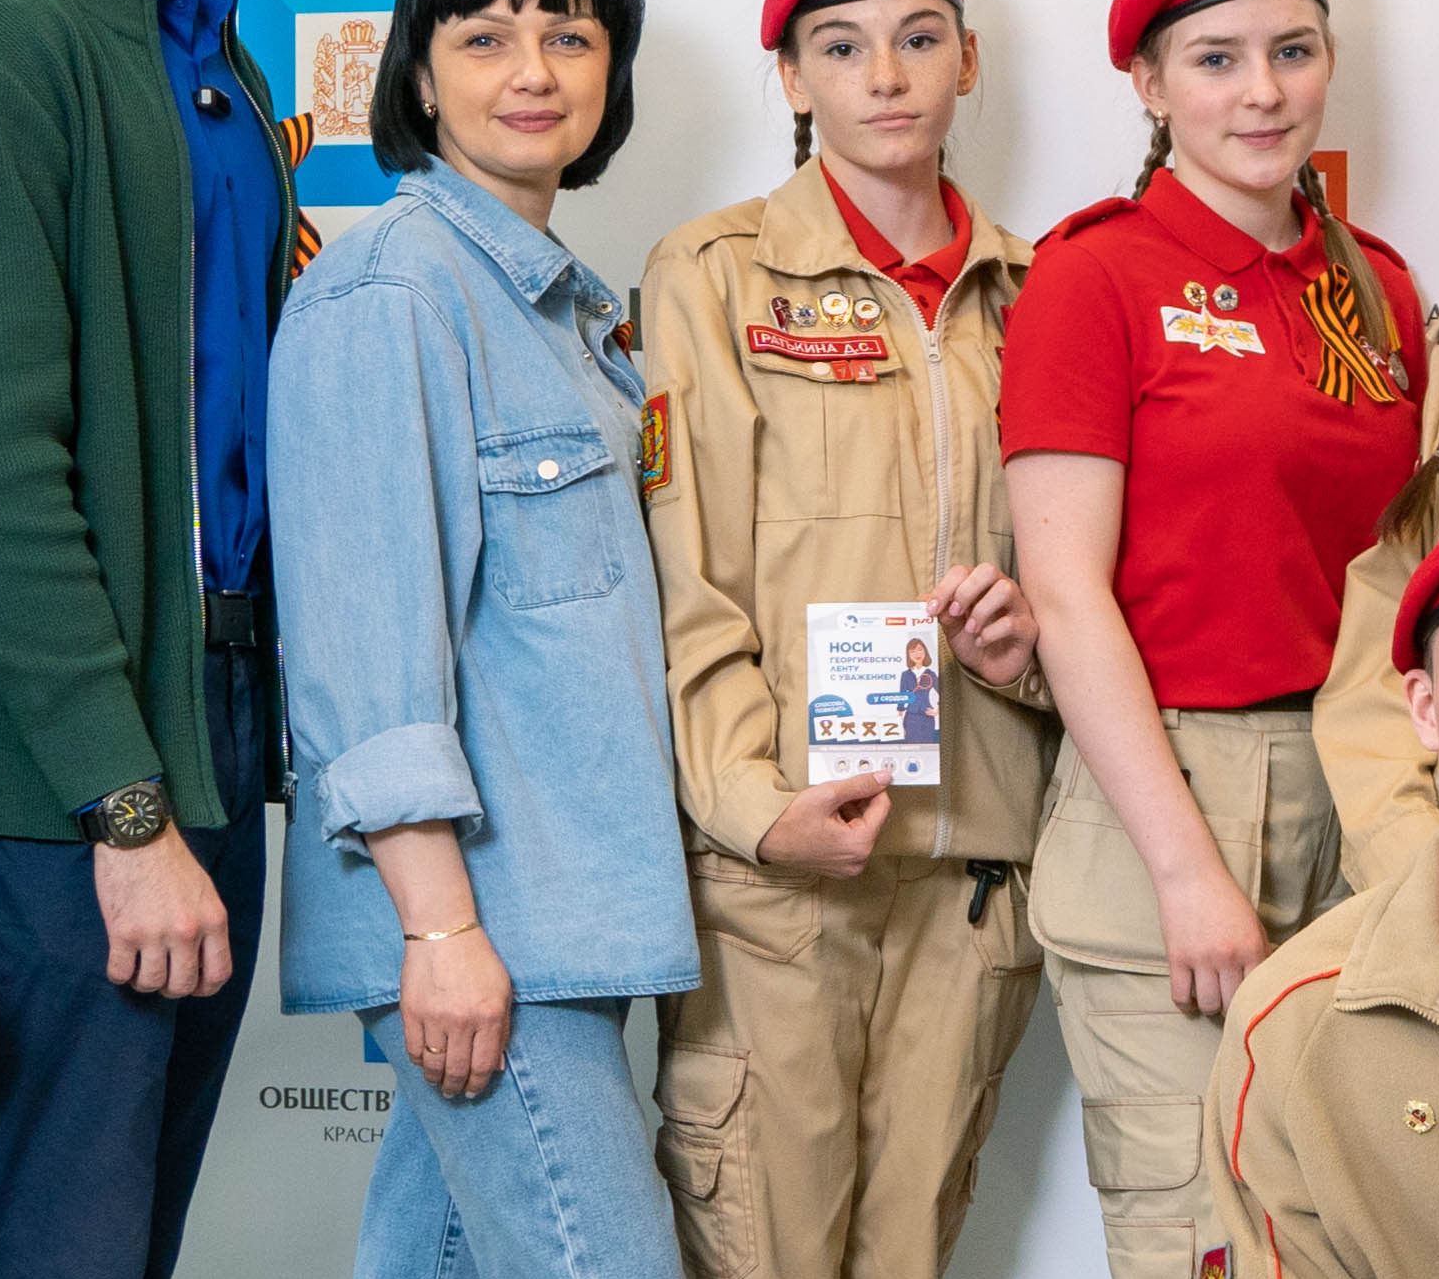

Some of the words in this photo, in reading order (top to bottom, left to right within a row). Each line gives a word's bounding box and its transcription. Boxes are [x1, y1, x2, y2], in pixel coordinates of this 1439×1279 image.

[829, 641, 873, 653] НОСИ
[829, 656, 903, 664] ГЕОРГИЕВСКУЮ
[829, 665, 860, 673] ЛЕНТУ
[839, 673, 897, 681] УВАЖЕНИЕМ
[259, 1086, 395, 1112] ОБЩЕСТВ
